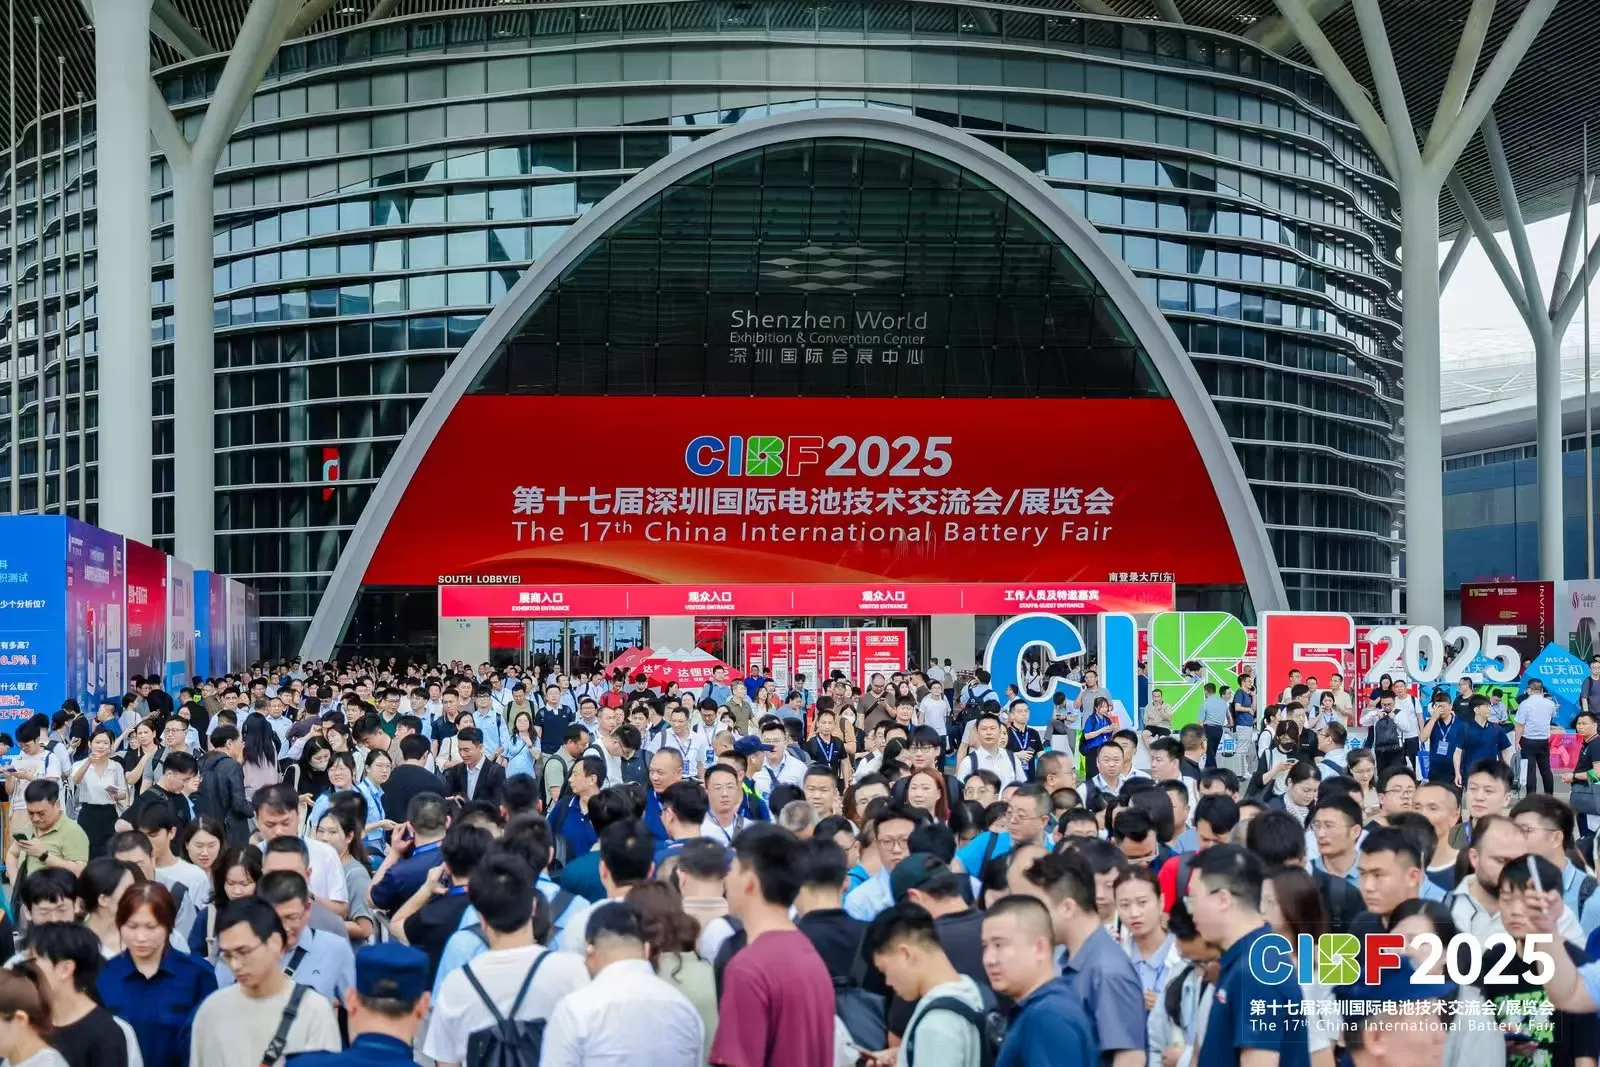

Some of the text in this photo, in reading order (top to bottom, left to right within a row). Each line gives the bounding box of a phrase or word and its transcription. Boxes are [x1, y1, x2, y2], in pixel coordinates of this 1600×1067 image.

[730, 310, 928, 330] Shenzhen World
[730, 331, 925, 345] Exhibition & Convention Center
[729, 348, 924, 364] 深圳国际会展中心
[512, 486, 1115, 516] 第十七届深圳国际电池技术交流会/展览会
[511, 520, 1114, 547] The 17th China International Battery Fair
[438, 575, 521, 584] SOUTH LOBBY(E)
[1108, 571, 1176, 583] 南登录大厅(东)
[519, 592, 563, 603] 展商入口
[688, 591, 732, 603] 观众入口
[862, 590, 905, 602] 观众入口
[1364, 625, 1521, 683] 2025
[678, 667, 729, 678] 达锂BS
[1540, 664, 1584, 675] 中天和
